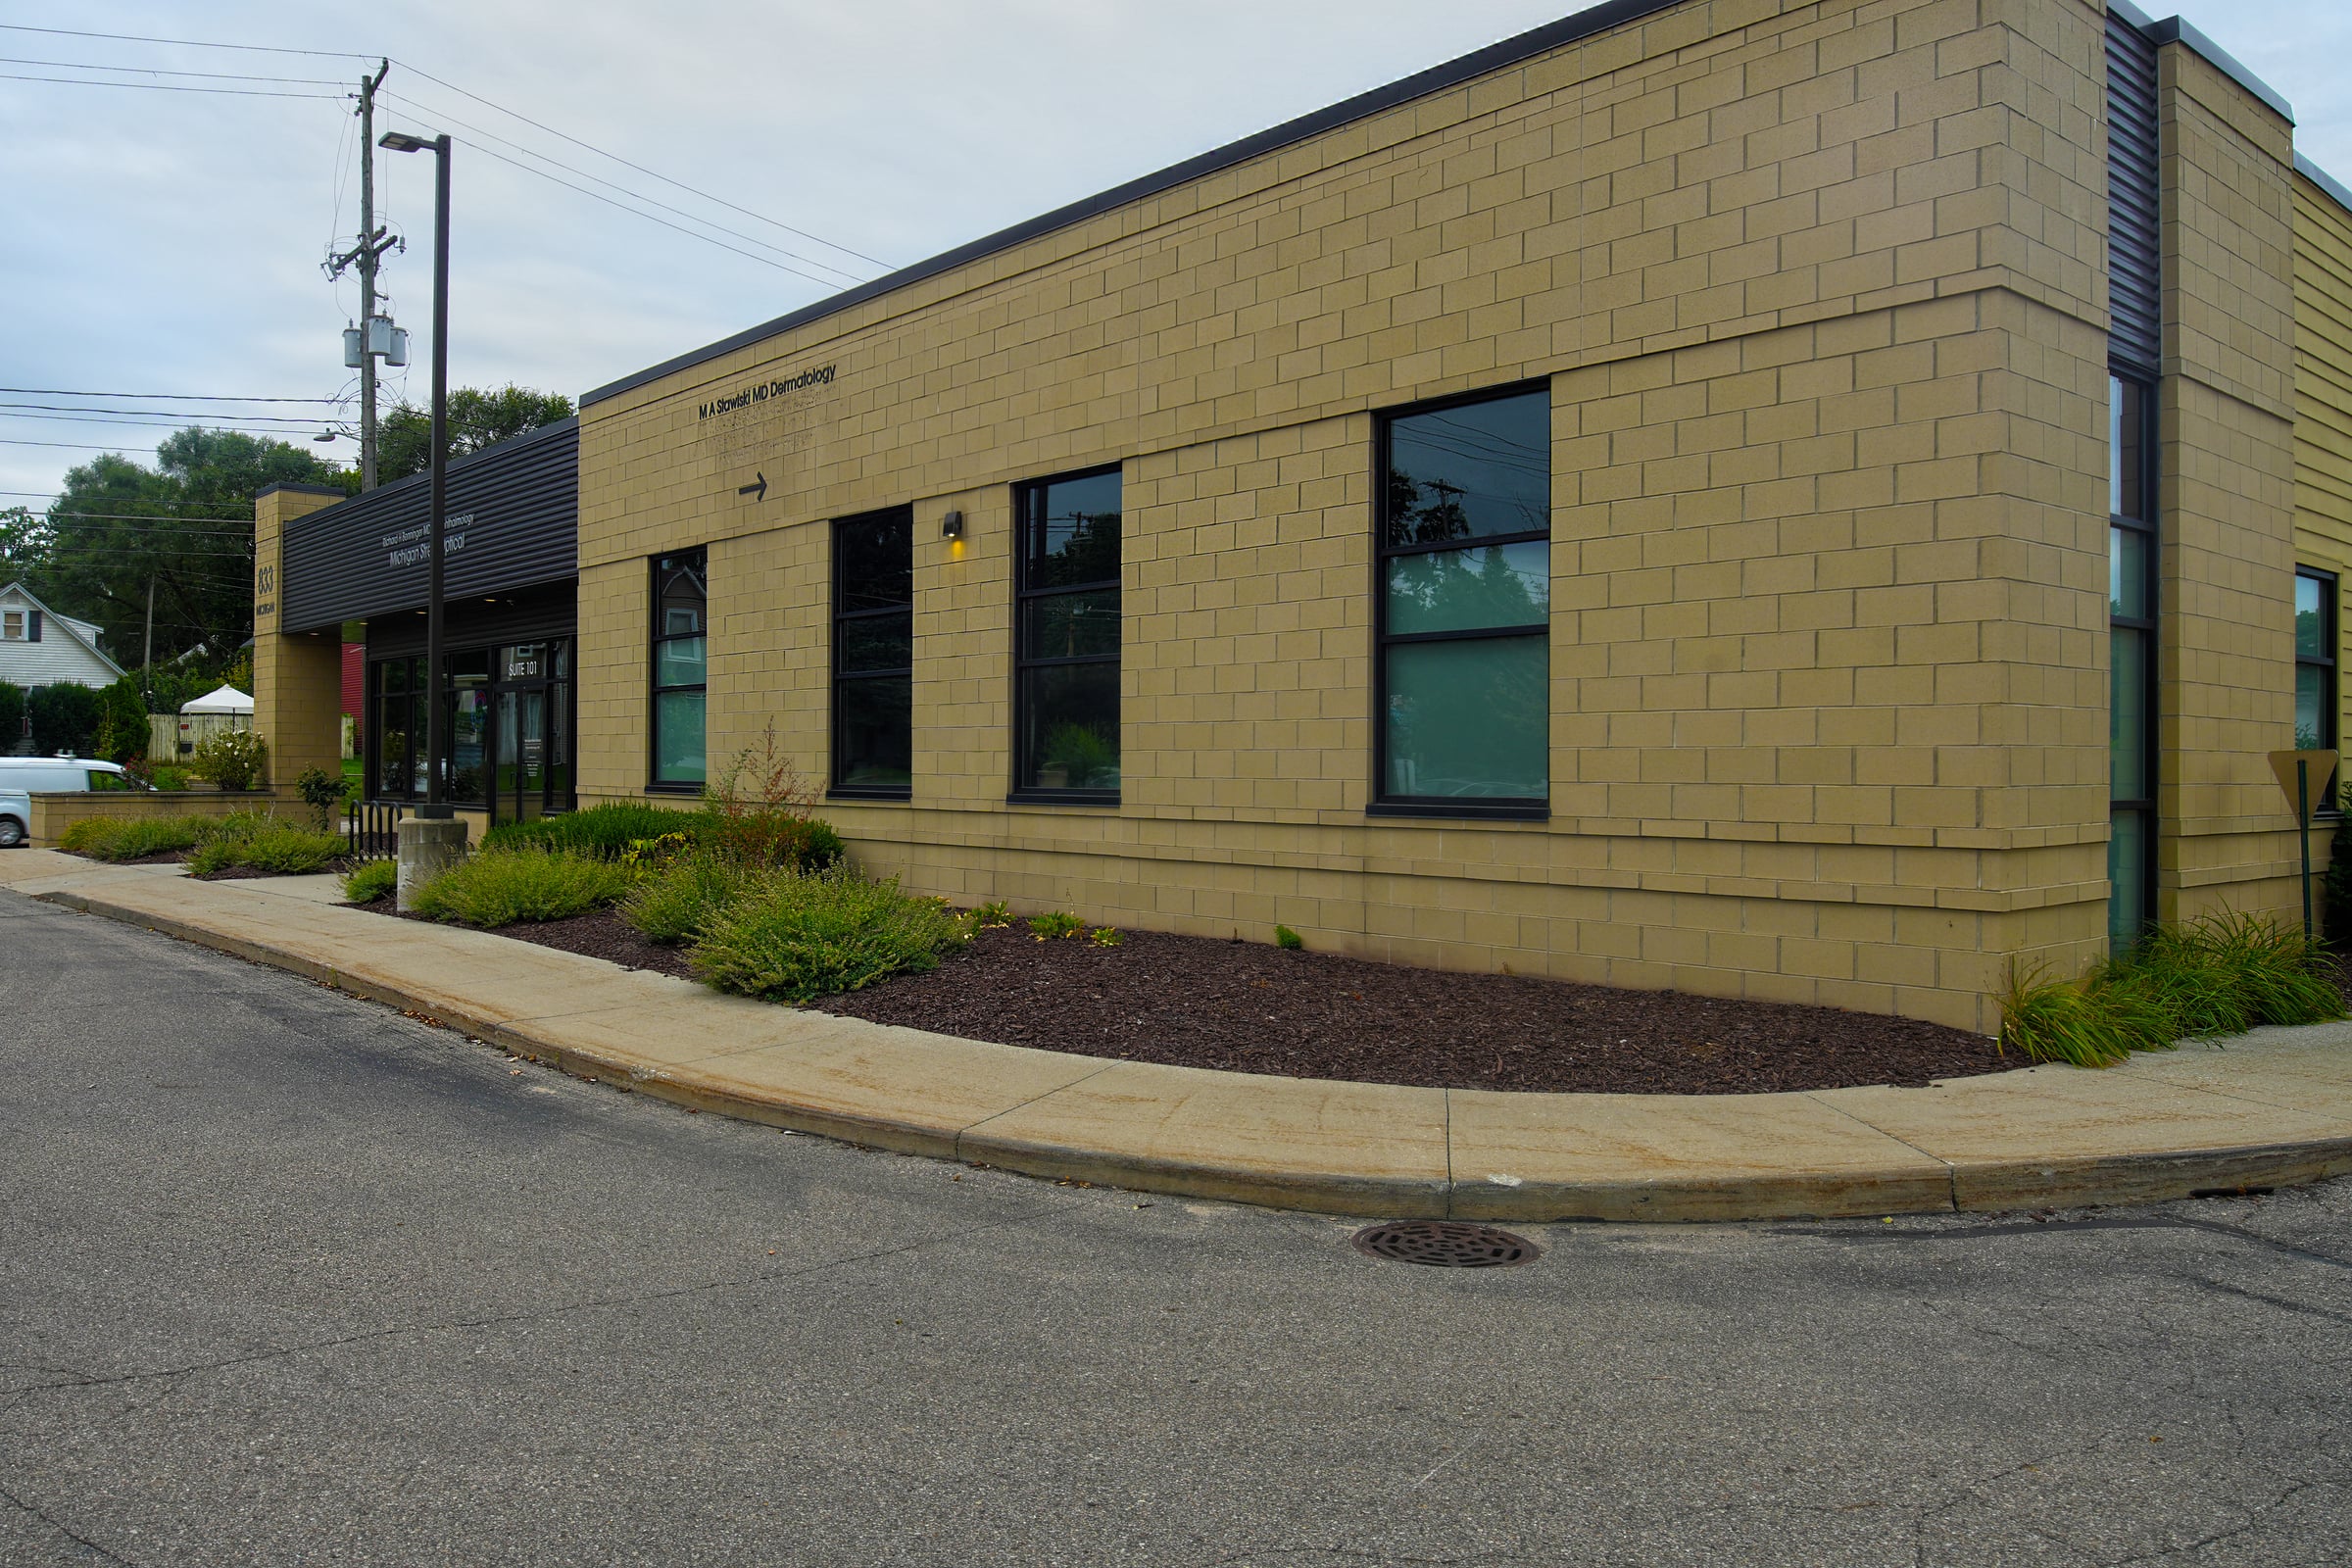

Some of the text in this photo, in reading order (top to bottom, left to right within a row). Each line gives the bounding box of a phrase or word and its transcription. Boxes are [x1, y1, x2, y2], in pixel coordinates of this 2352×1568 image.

[699, 404, 708, 420] M
[709, 402, 716, 416] A
[753, 384, 768, 403] MD
[770, 364, 836, 398] Dermatology
[444, 513, 474, 529] hthalmology
[390, 531, 466, 567] Michigan Stre ptical
[258, 564, 273, 595] 833
[509, 661, 537, 677] SUITE 101
